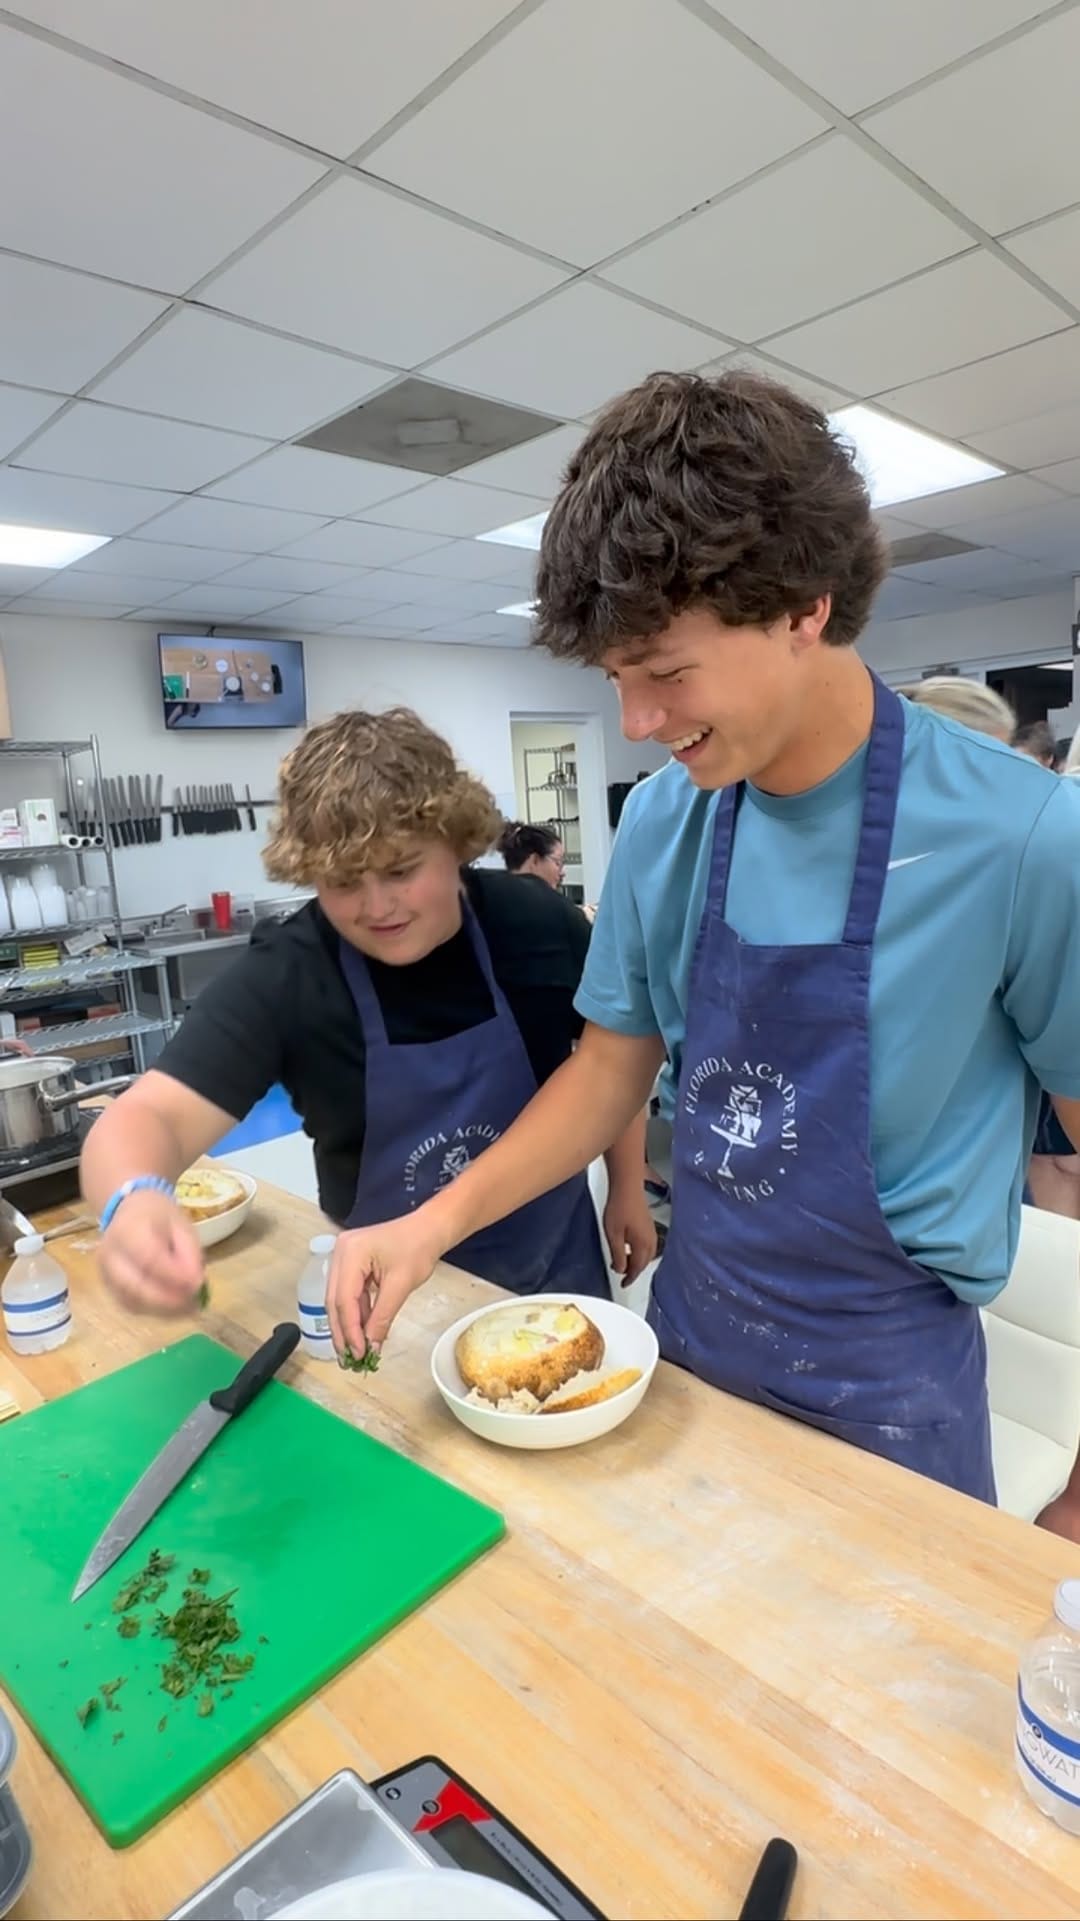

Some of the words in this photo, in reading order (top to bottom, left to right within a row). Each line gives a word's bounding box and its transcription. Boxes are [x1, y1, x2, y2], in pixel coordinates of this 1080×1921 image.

[684, 1056, 733, 1115] FLORIDA
[739, 1060, 798, 1156] ACADEMY
[404, 1132, 448, 1192] FLORIDA
